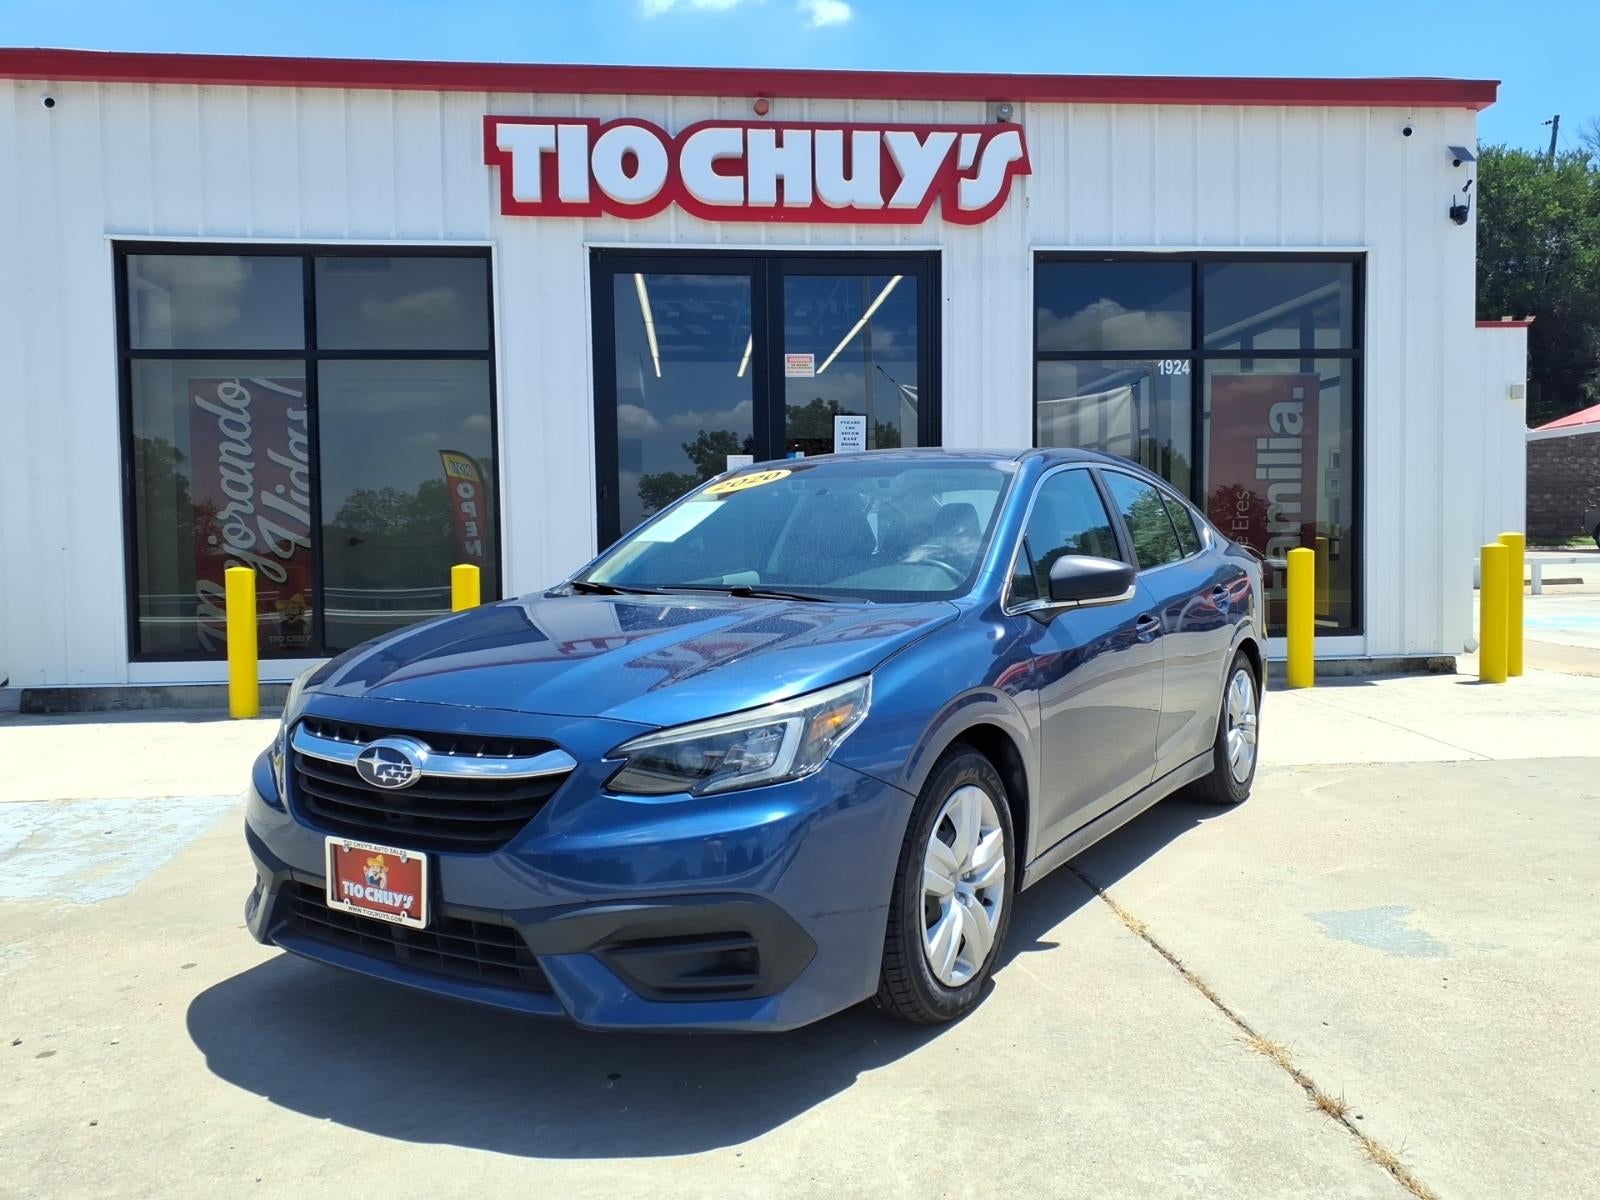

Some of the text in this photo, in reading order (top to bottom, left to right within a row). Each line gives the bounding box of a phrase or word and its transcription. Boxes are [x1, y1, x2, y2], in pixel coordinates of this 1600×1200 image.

[495, 122, 1025, 213] TIO CHUY'S
[1157, 359, 1191, 376] 1924
[712, 471, 782, 492] 2020
[1231, 490, 1250, 530] Eres
[353, 841, 373, 850] CHUY'S
[373, 845, 389, 853] AUTO
[389, 848, 407, 856] SALES
[342, 880, 414, 909] TIO CHUY'S
[347, 905, 403, 922] WWW.TIOCHUYS.COM
